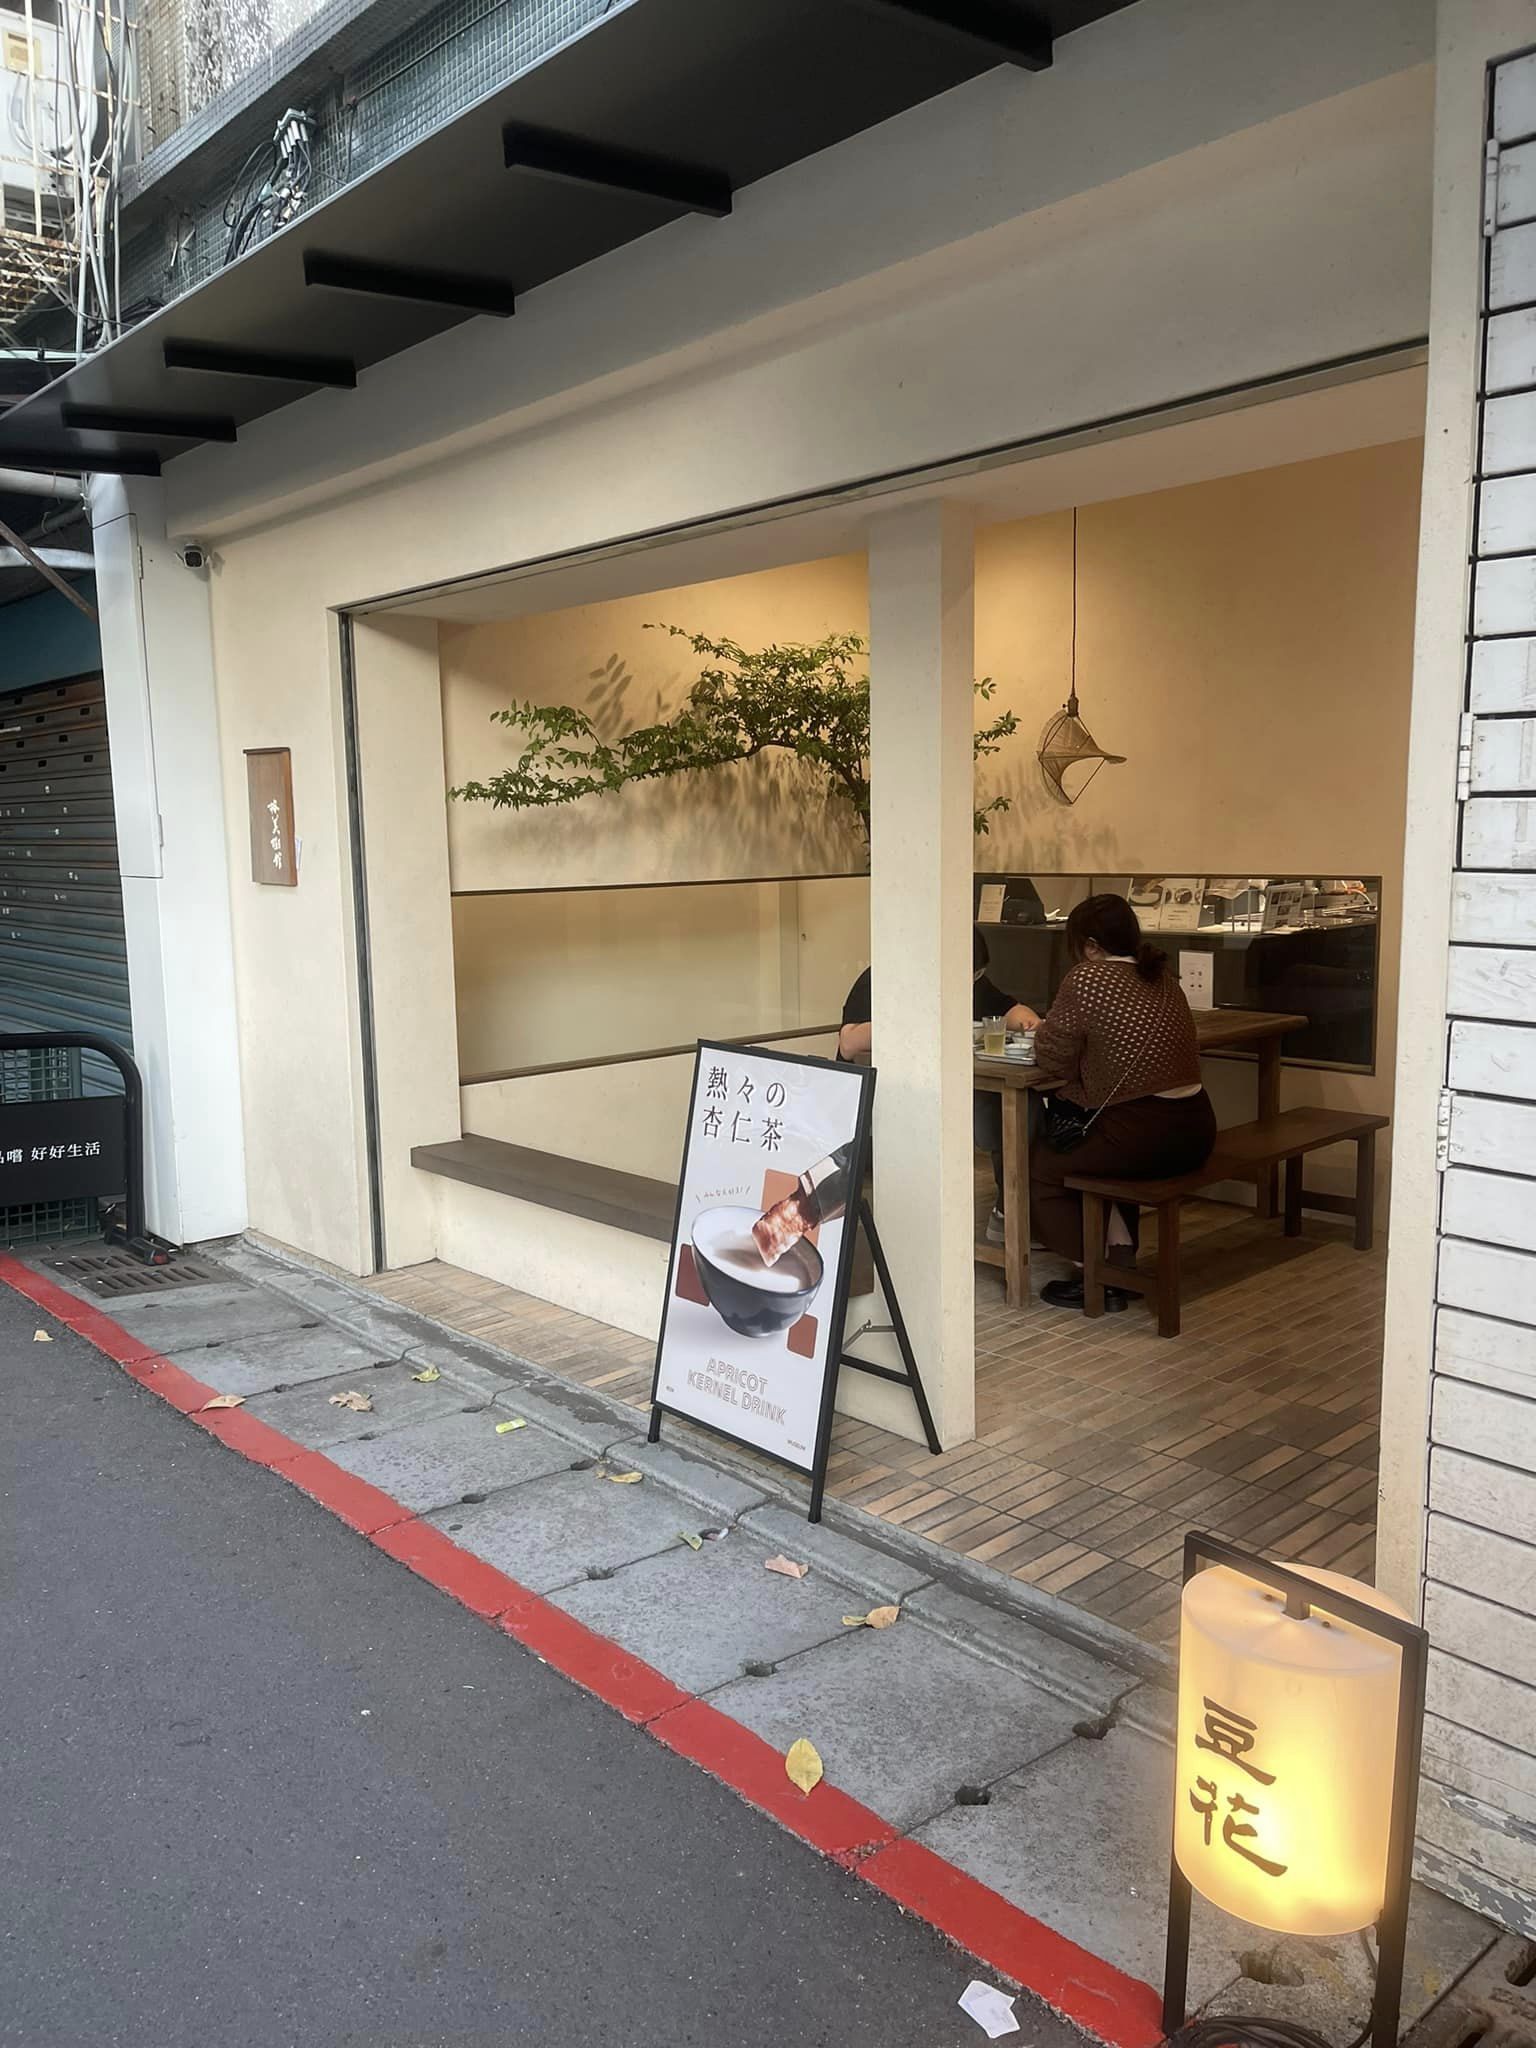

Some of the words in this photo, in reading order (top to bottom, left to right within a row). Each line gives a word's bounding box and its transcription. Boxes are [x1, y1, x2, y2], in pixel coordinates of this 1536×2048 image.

[706, 1066, 786, 1108] 熱々の
[703, 1105, 784, 1152] 杏仁茶
[31, 1141, 101, 1161] 好好生活
[687, 1369, 738, 1406] KERNEL
[741, 1392, 787, 1425] DRINK
[706, 1358, 768, 1395] APRICOT
[1189, 1695, 1288, 1877] 豆花
